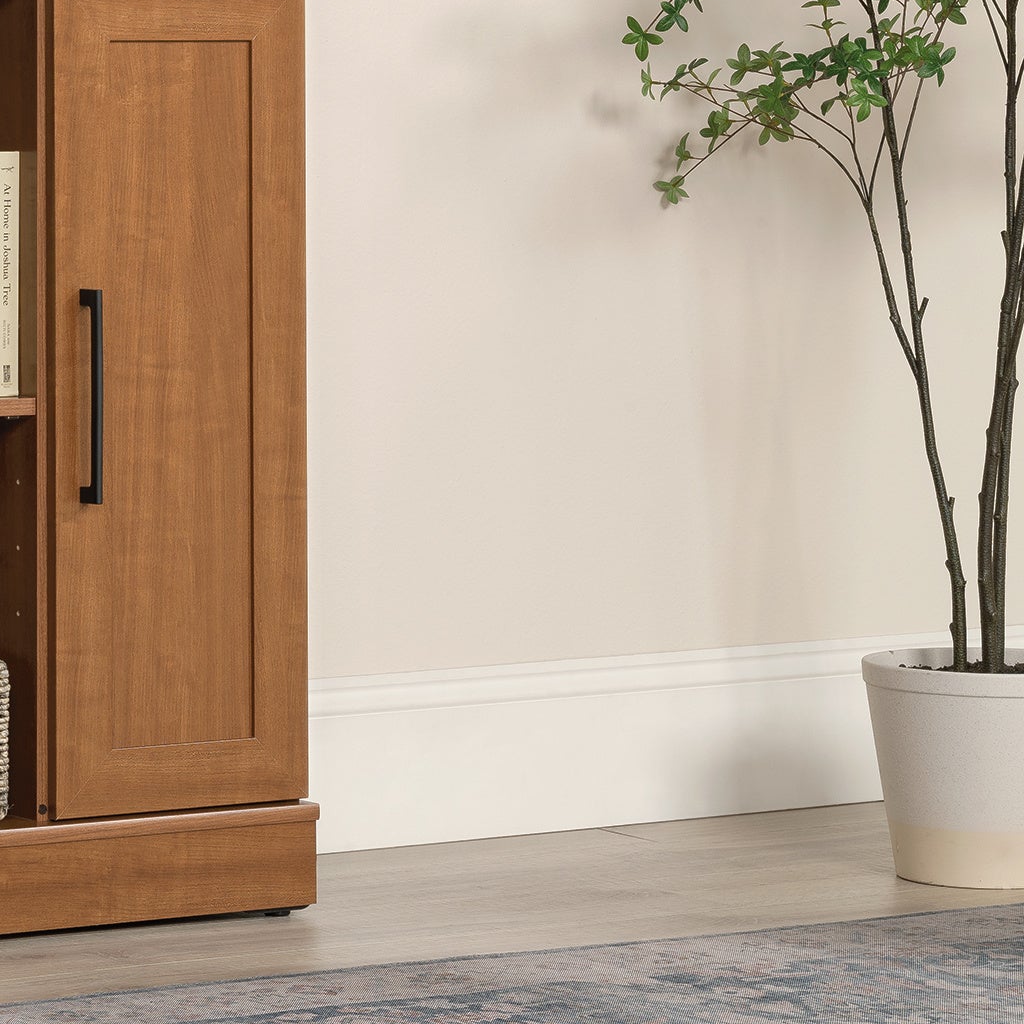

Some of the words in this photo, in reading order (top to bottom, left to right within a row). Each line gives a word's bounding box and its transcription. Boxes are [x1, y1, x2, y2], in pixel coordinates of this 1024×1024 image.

[3, 183, 12, 196] At
[3, 199, 12, 230] Home
[3, 232, 10, 241] in
[3, 244, 12, 281] Joshua
[3, 284, 11, 306] Tree
